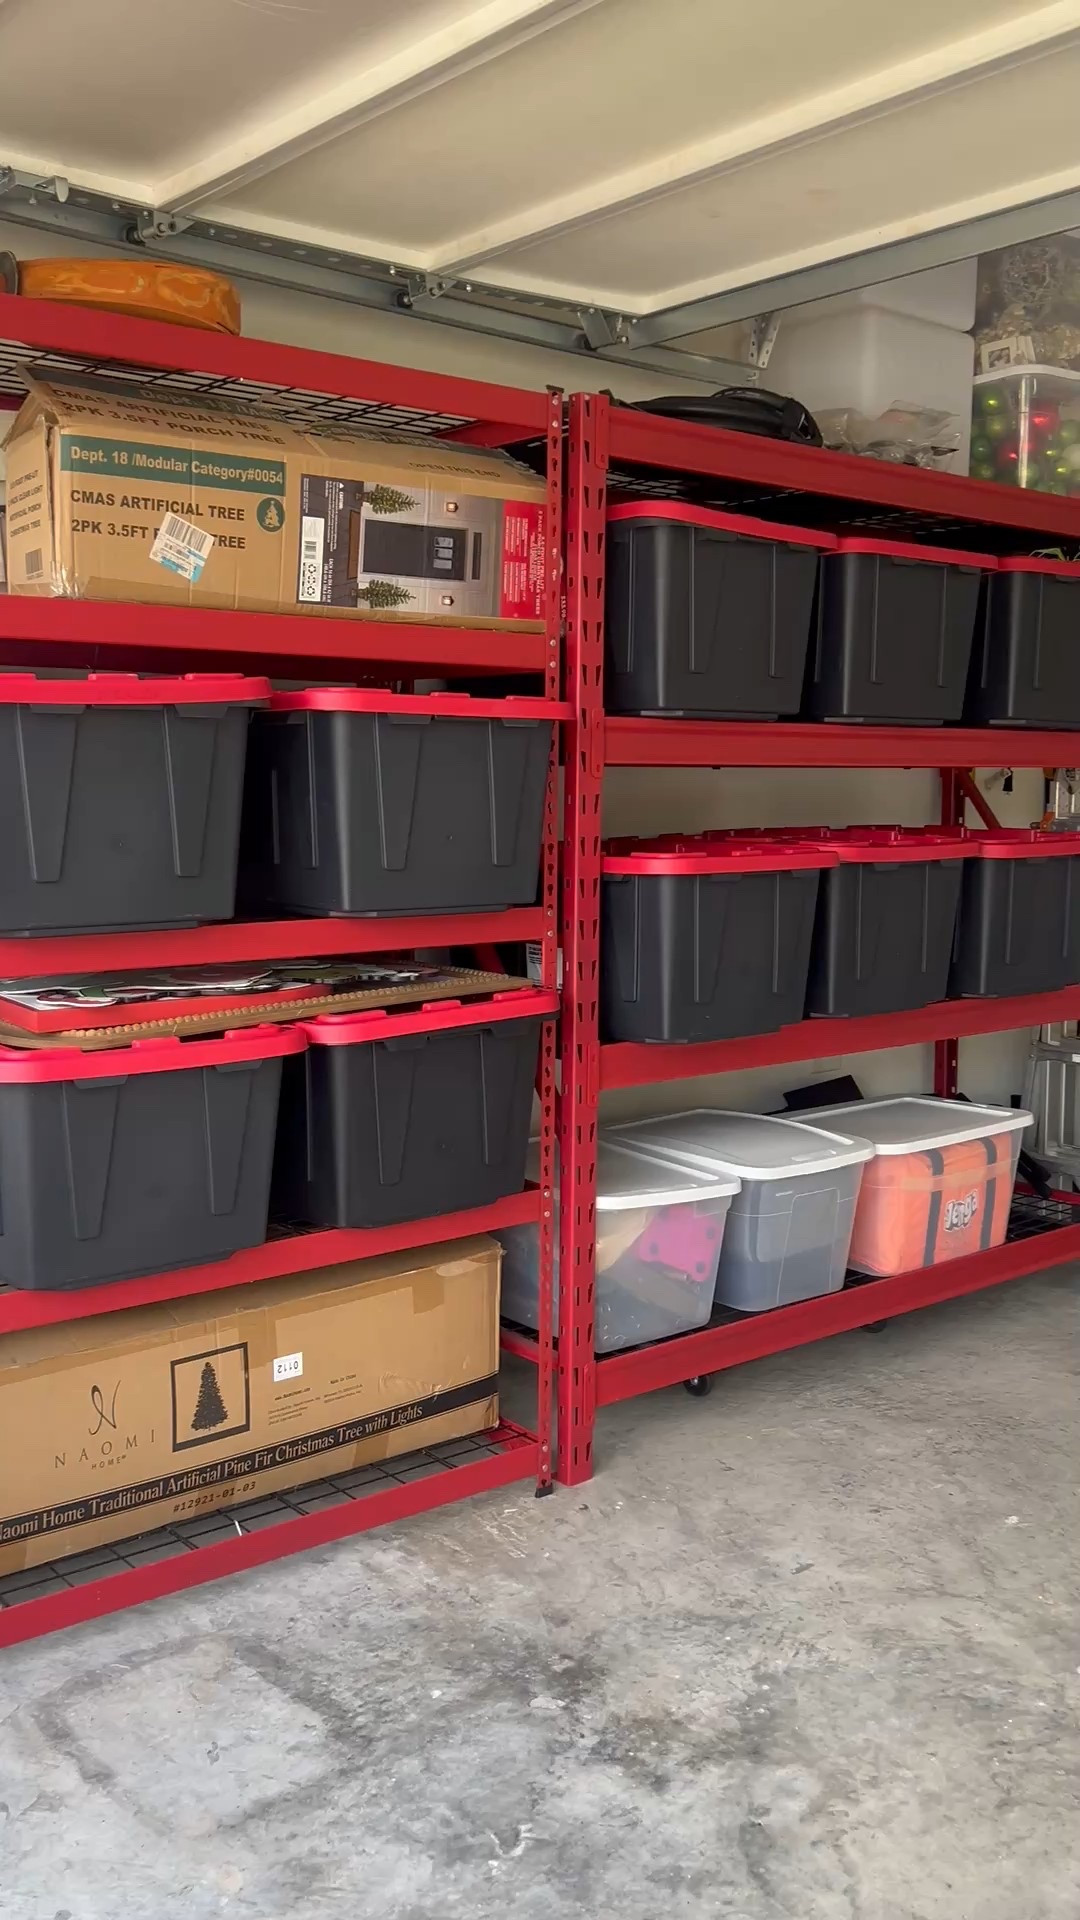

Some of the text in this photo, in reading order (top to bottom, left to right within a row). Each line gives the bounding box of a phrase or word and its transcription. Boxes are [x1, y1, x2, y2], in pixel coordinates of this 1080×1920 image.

[52, 389, 273, 432] CMAS ARTIFICIAL TREE
[61, 401, 287, 446] 2PK 3.5FT PORCH TREE
[70, 446, 284, 484] Dept. 18 /Modular Category#0054
[70, 489, 245, 521] CMAS ARTIFICIAL TREE
[71, 518, 103, 535] 2PK
[107, 521, 149, 540] 3.5FT
[210, 533, 247, 550] TREE
[277, 1360, 300, 1374] 0112
[42, 1506, 85, 1529] Home
[88, 1482, 163, 1516] Traditional
[166, 1464, 221, 1494] Artificial
[224, 1458, 251, 1478] Pine
[254, 1450, 274, 1468] Fir
[275, 1432, 335, 1462] Christmas
[337, 1425, 363, 1443] Tree
[365, 1416, 388, 1434] with
[390, 1406, 423, 1427] Lights
[54, 1429, 155, 1469] NAOMI
[173, 1481, 256, 1513] #12921-01-03
